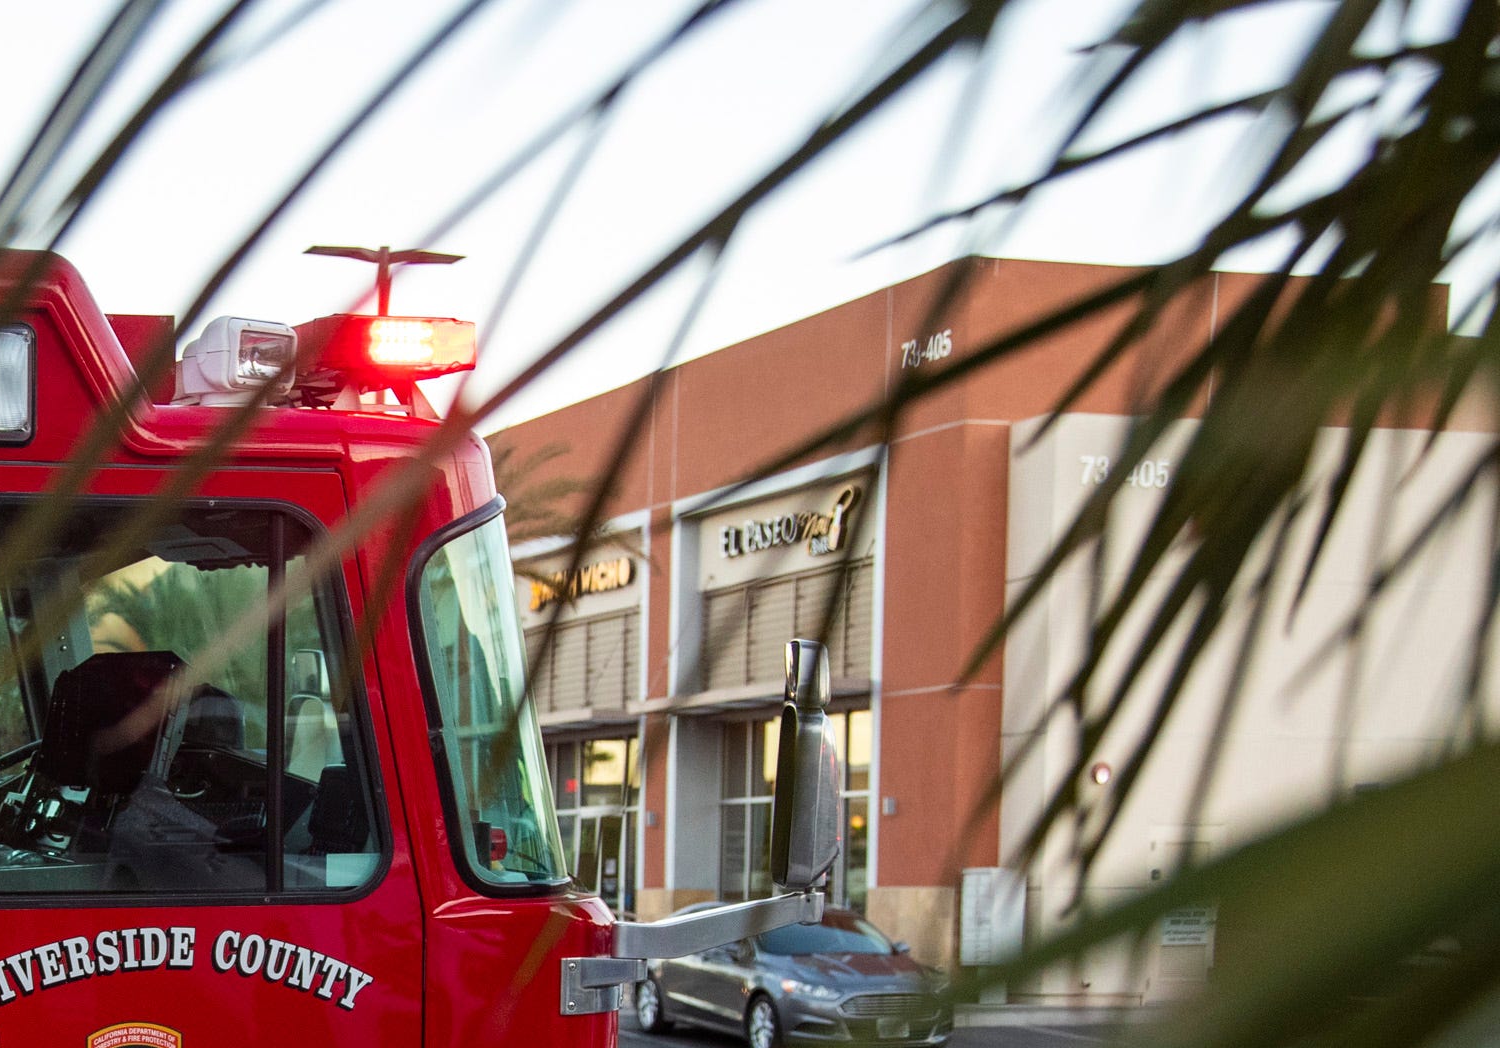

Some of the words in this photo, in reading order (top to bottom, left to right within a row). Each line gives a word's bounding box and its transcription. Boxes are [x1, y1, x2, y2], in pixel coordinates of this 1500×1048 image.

[719, 525, 739, 558] EL
[742, 512, 798, 554] PASEO
[211, 929, 373, 1010] COUNTY
[93, 1027, 128, 1046] CALIFORNIA
[128, 1026, 167, 1039] DEPARTMENT
[167, 1033, 177, 1043] OF
[122, 1035, 128, 1043] &
[128, 1034, 141, 1043] FIRE
